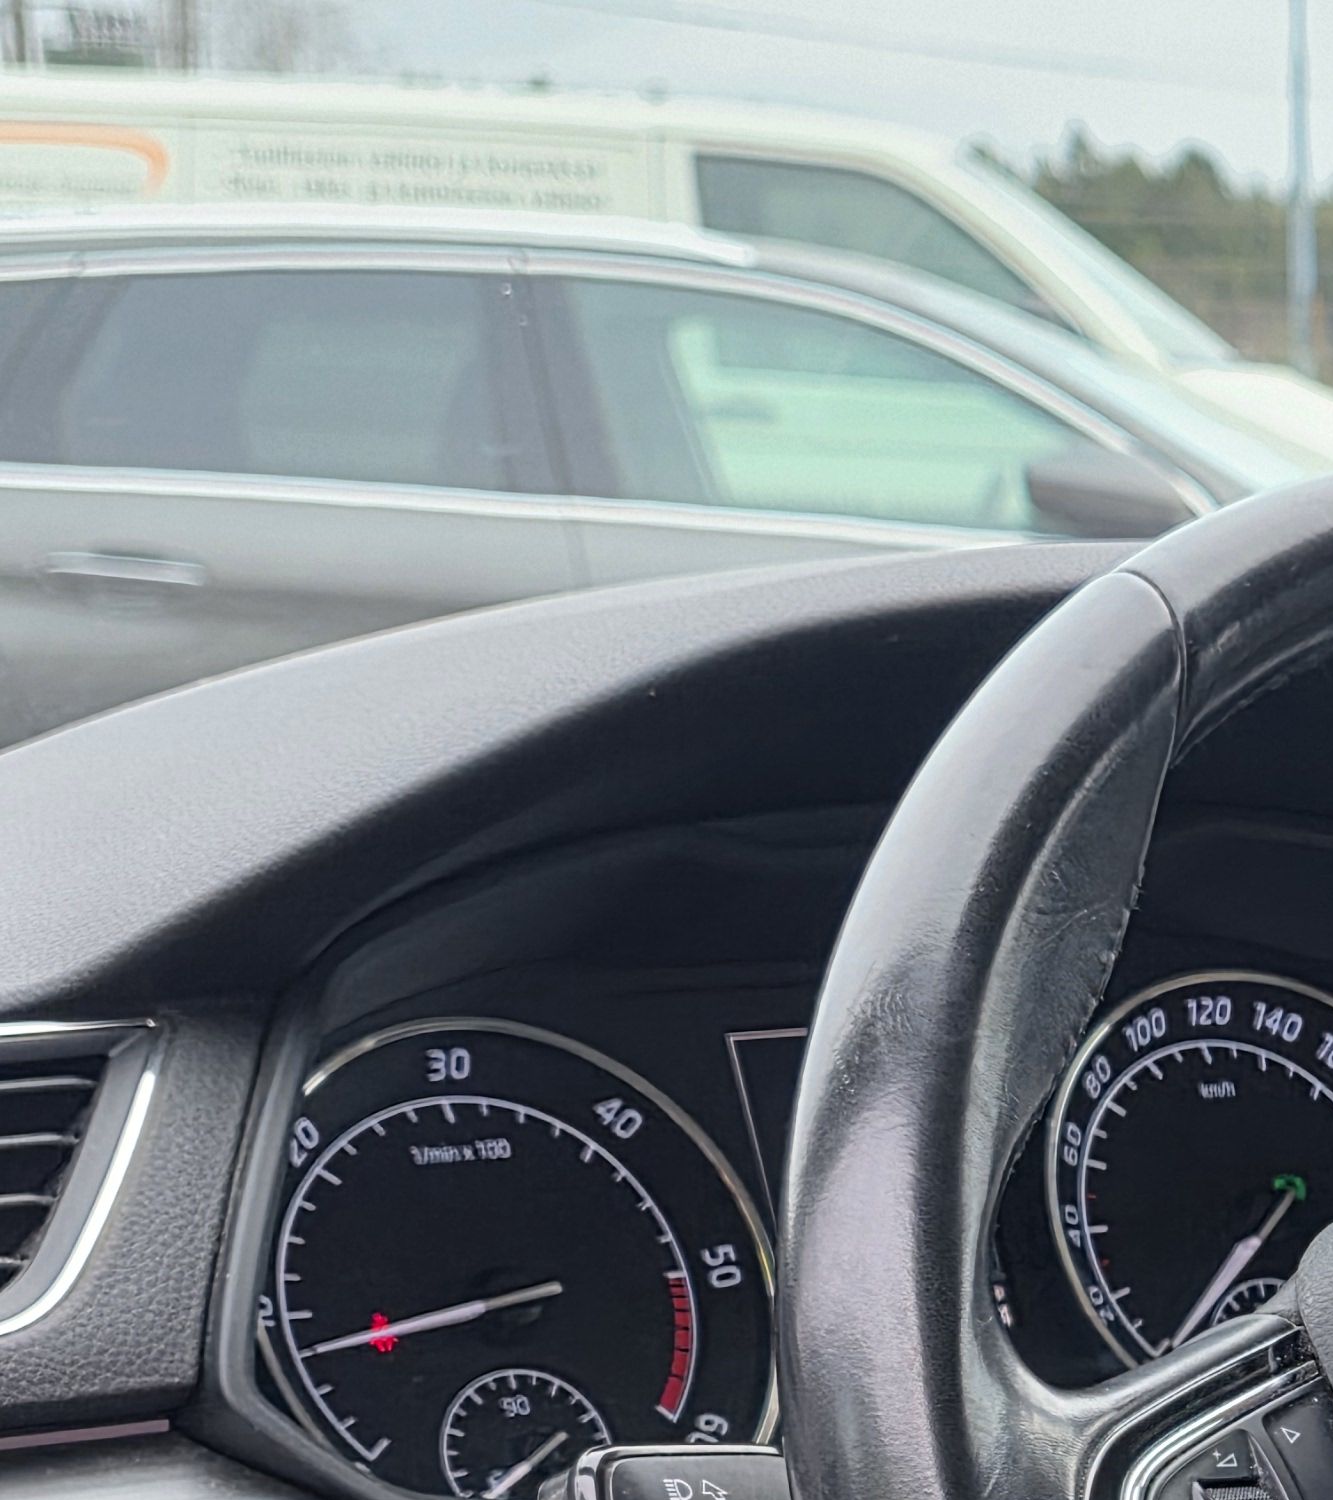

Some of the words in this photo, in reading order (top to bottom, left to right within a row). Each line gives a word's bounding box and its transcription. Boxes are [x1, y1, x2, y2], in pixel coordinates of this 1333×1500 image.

[1122, 1007, 1167, 1052] 100
[1187, 995, 1232, 1027] 120
[1252, 1001, 1304, 1043] 140
[425, 1047, 472, 1083] 30
[1082, 1054, 1112, 1100] 80
[1199, 1080, 1237, 1100] km/h
[592, 1096, 644, 1140] 40
[289, 1115, 320, 1169] 20
[474, 1136, 513, 1161] 100
[1062, 1121, 1082, 1167] 60
[1063, 1203, 1081, 1248] 40
[701, 1242, 743, 1290] 50
